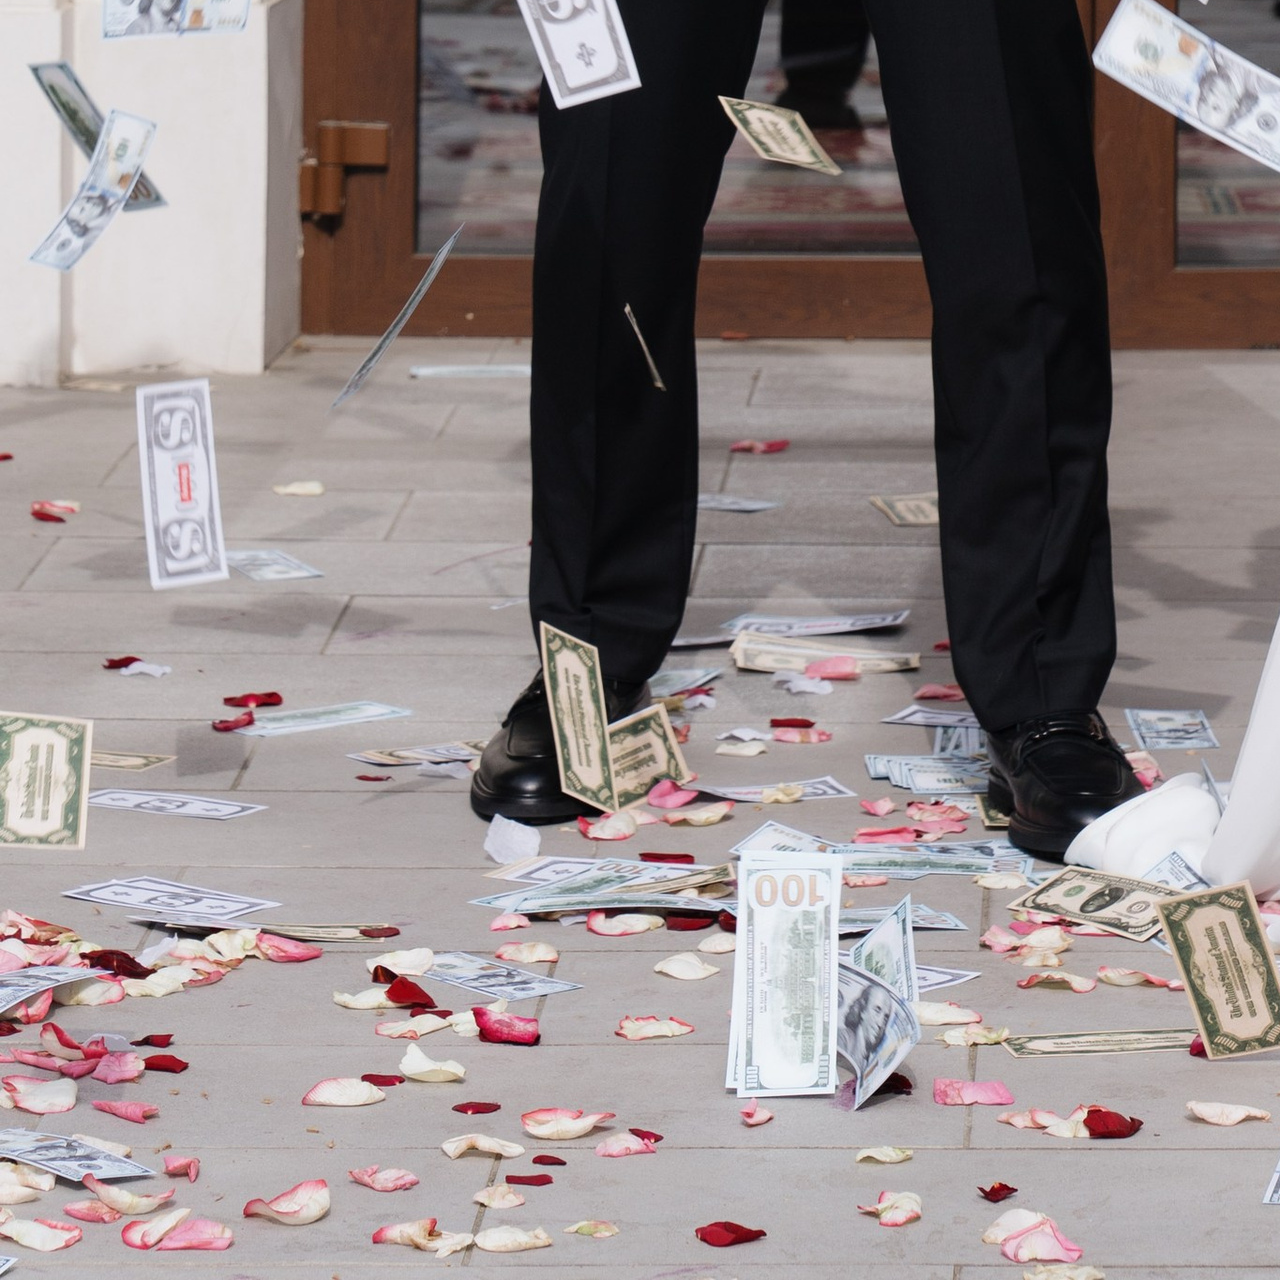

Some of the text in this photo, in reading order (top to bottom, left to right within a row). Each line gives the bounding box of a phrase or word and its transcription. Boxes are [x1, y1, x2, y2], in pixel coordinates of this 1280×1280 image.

[600, 863, 649, 875] 100
[755, 874, 825, 908] 100
[1204, 926, 1221, 954] America
[1218, 960, 1231, 984] States
[1224, 982, 1239, 1007] United
[1230, 1006, 1244, 1020] The
